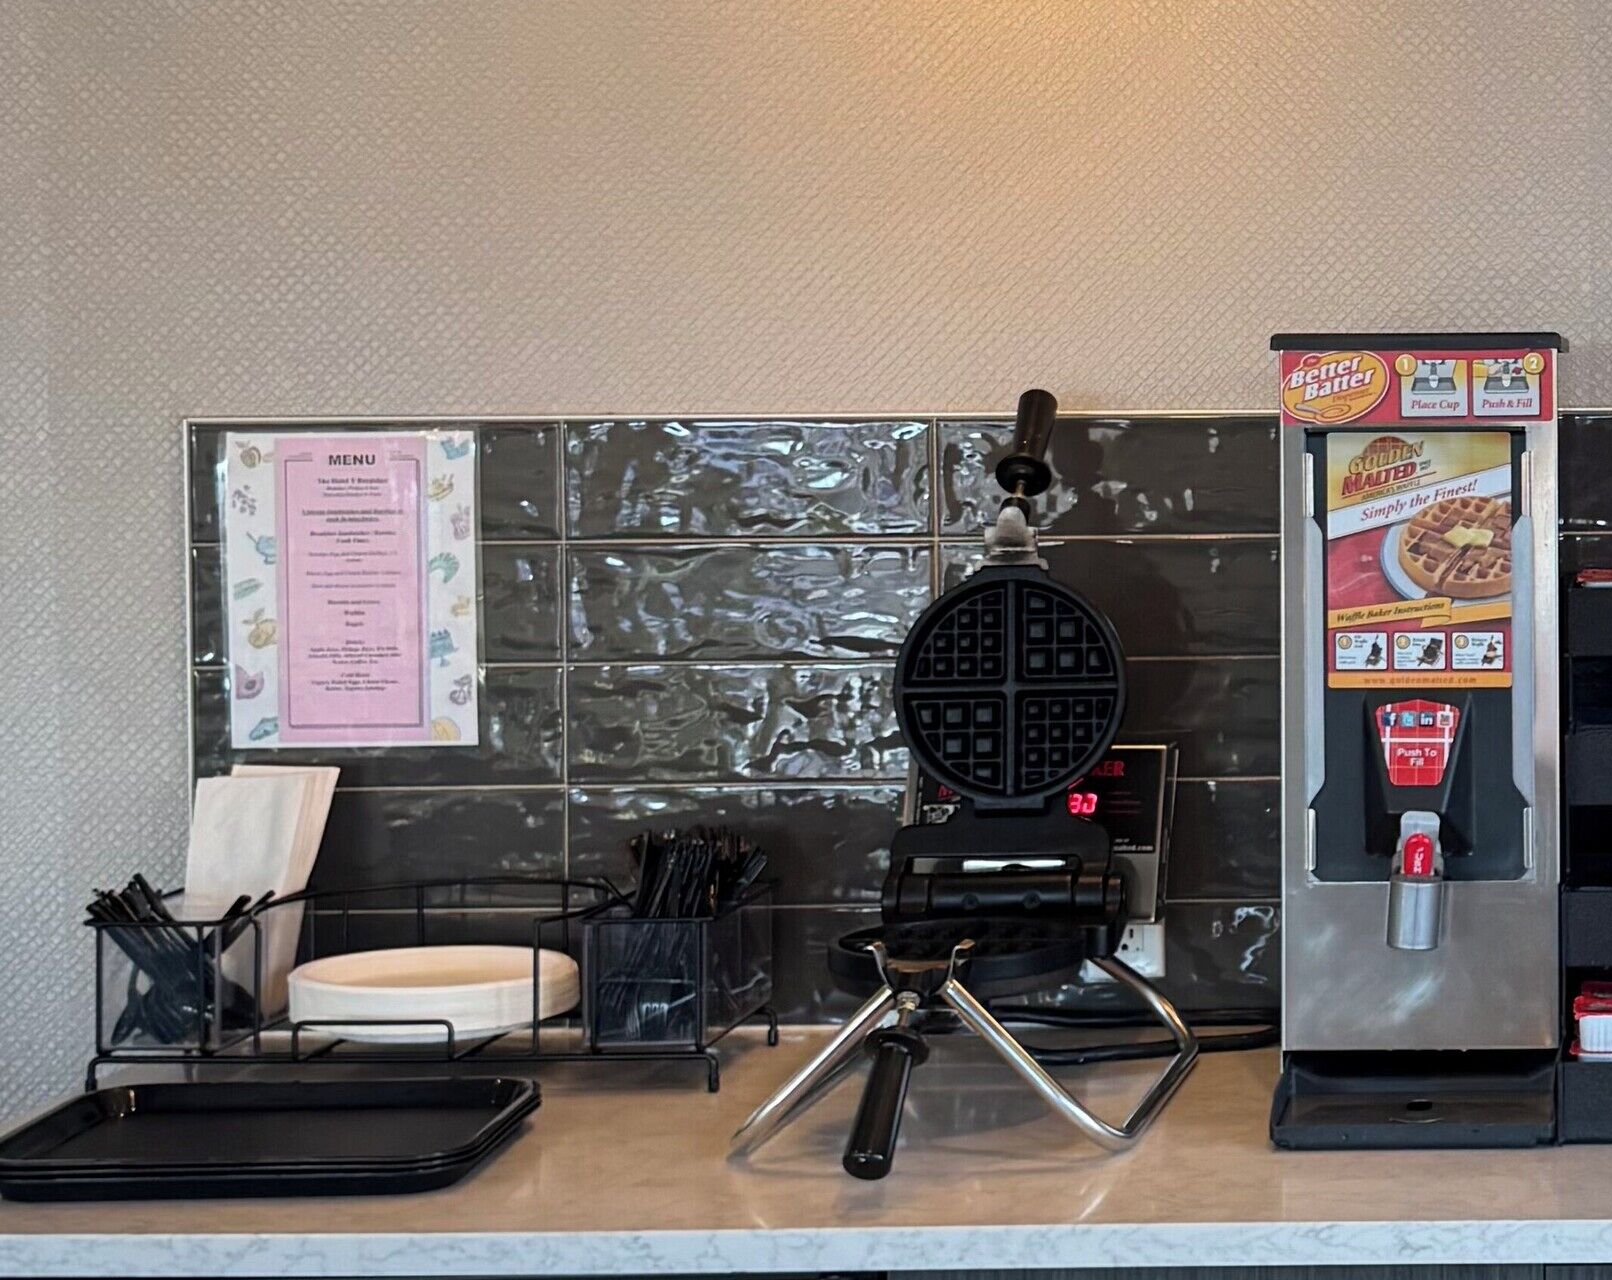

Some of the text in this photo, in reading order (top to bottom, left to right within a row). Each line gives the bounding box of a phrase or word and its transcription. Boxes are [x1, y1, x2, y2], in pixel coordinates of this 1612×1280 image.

[1402, 359, 1409, 369] 1
[1530, 358, 1537, 368] 2
[1411, 399, 1460, 411] Place Cup
[1482, 398, 1532, 409] Push & Fill
[328, 454, 376, 466] MENU
[1349, 440, 1425, 475] GOLDEN
[1342, 461, 1417, 496] MALTED
[1361, 477, 1478, 521] Simply the Finest!
[1337, 601, 1445, 623] Waffle Baker Instructions
[1396, 747, 1438, 757] Push To
[1410, 757, 1425, 766] Fill
